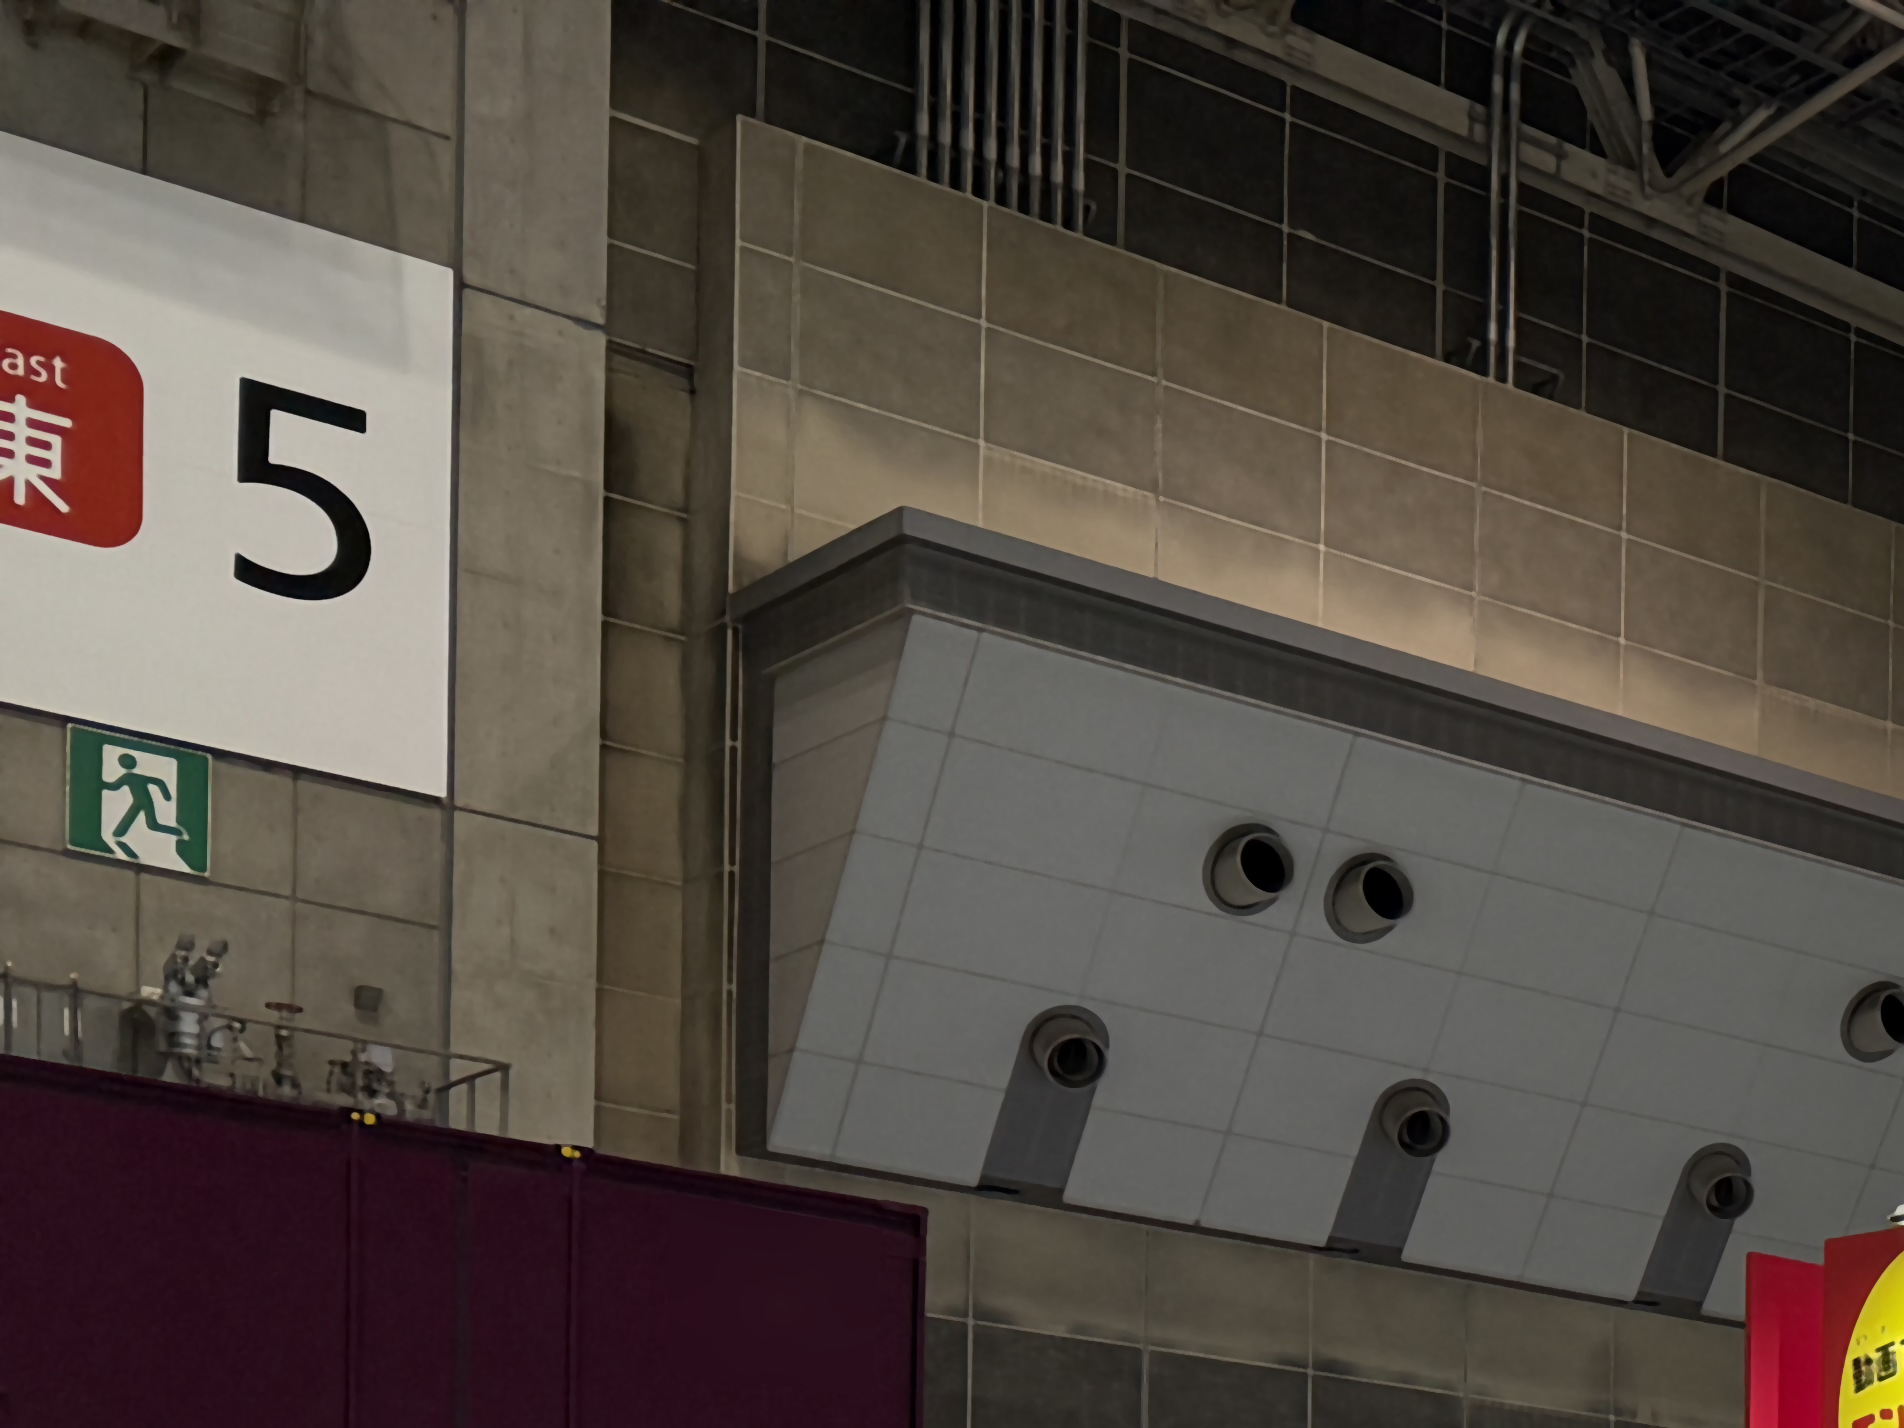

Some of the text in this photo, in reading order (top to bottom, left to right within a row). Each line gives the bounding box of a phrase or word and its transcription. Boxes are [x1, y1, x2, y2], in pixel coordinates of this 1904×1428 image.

[0, 347, 71, 389] ast
[0, 394, 73, 514] 東
[233, 376, 372, 601] 5
